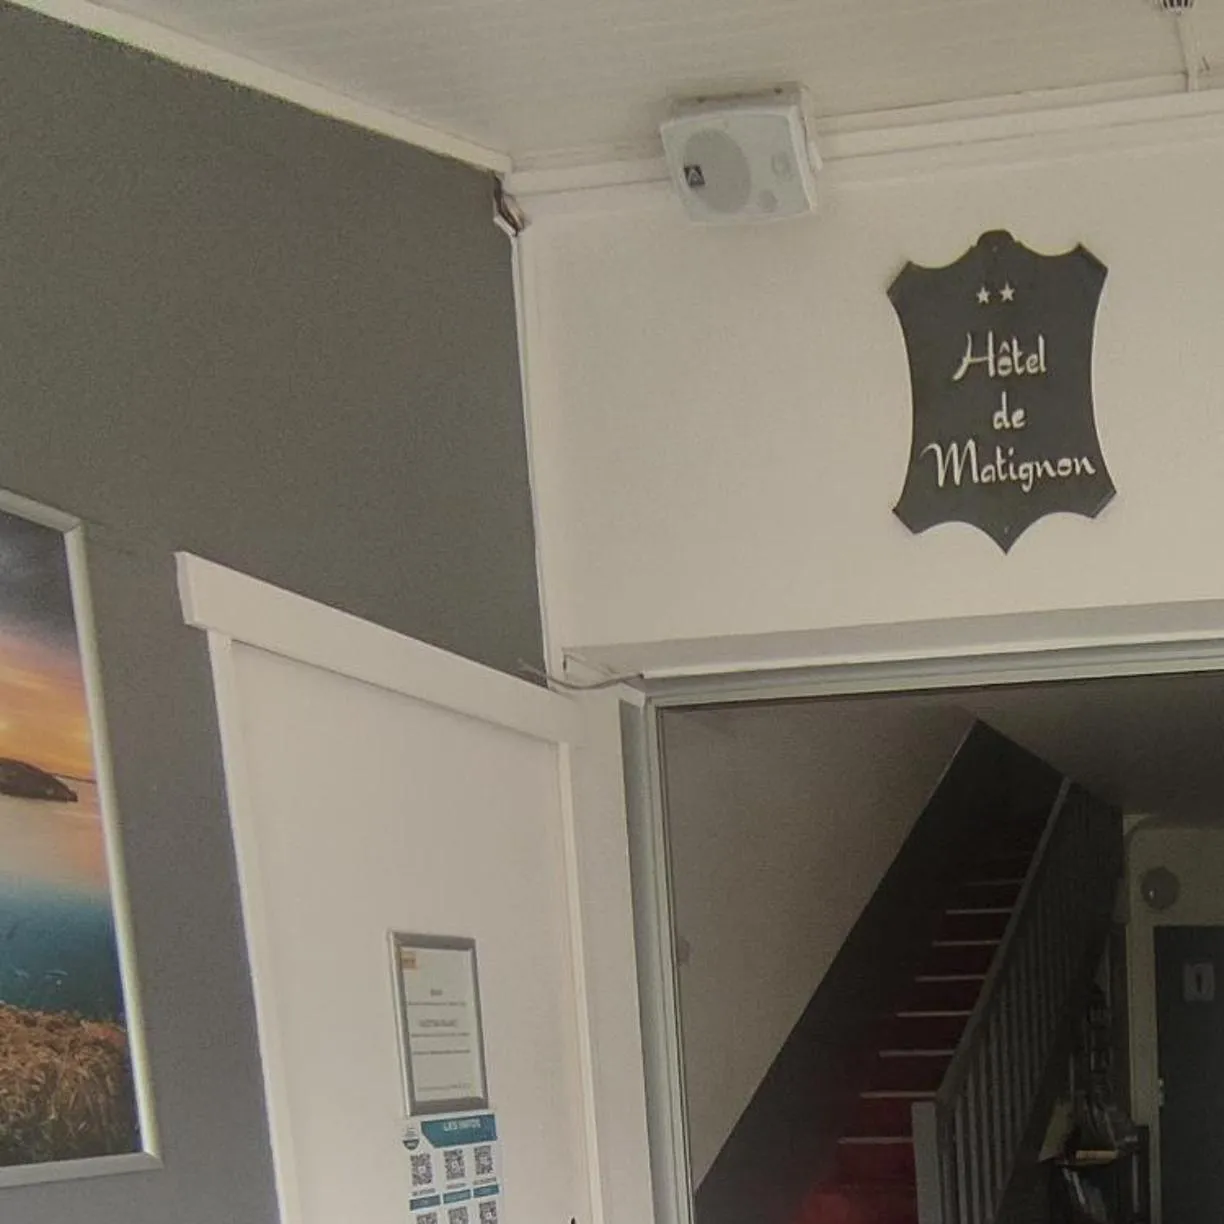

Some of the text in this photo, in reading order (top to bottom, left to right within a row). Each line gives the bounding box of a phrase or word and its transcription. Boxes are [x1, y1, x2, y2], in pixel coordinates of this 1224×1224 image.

[952, 330, 1046, 381] Hôtel
[993, 391, 1028, 430] de
[921, 438, 1097, 493] Matignon
